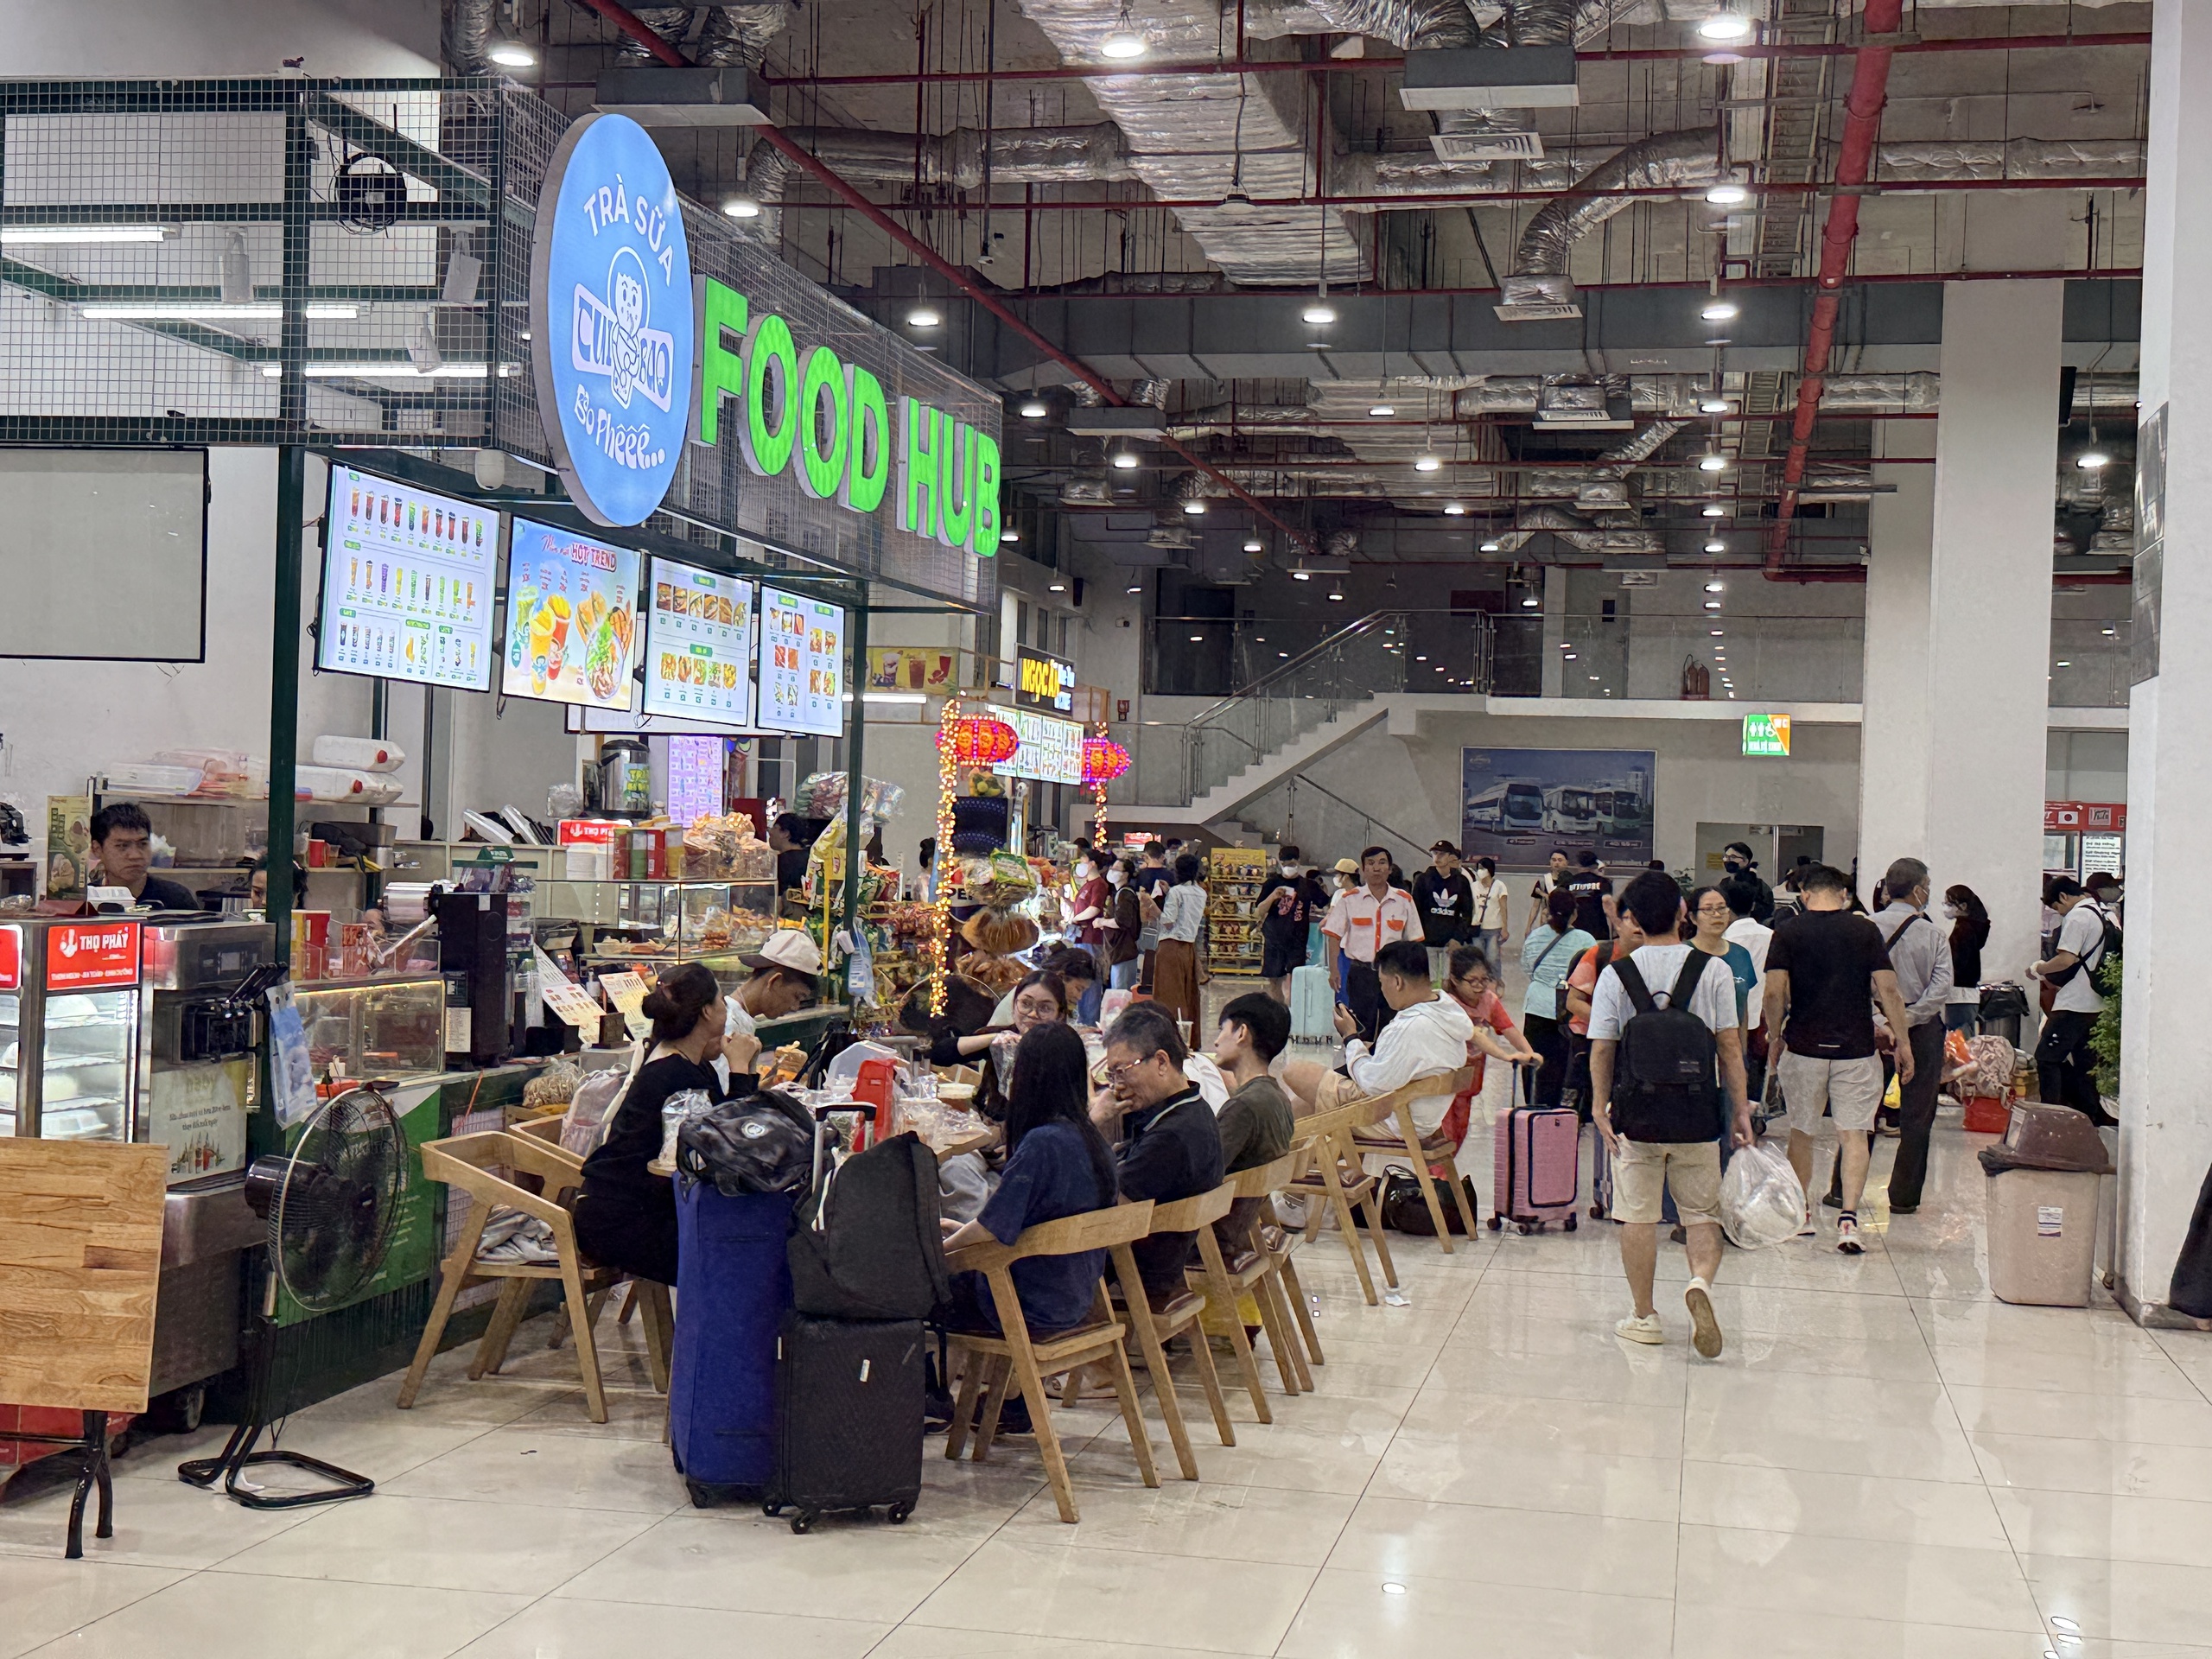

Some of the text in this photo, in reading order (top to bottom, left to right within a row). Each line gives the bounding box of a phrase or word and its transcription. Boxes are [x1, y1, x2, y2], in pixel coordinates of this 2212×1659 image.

[583, 173, 673, 287] TRÀ SỮA
[701, 276, 1001, 557] FOOD HUB
[571, 543, 589, 564] HOT
[591, 548, 617, 571] TREND
[1021, 658, 1048, 702] NGỌC
[79, 935, 100, 953] THỌ
